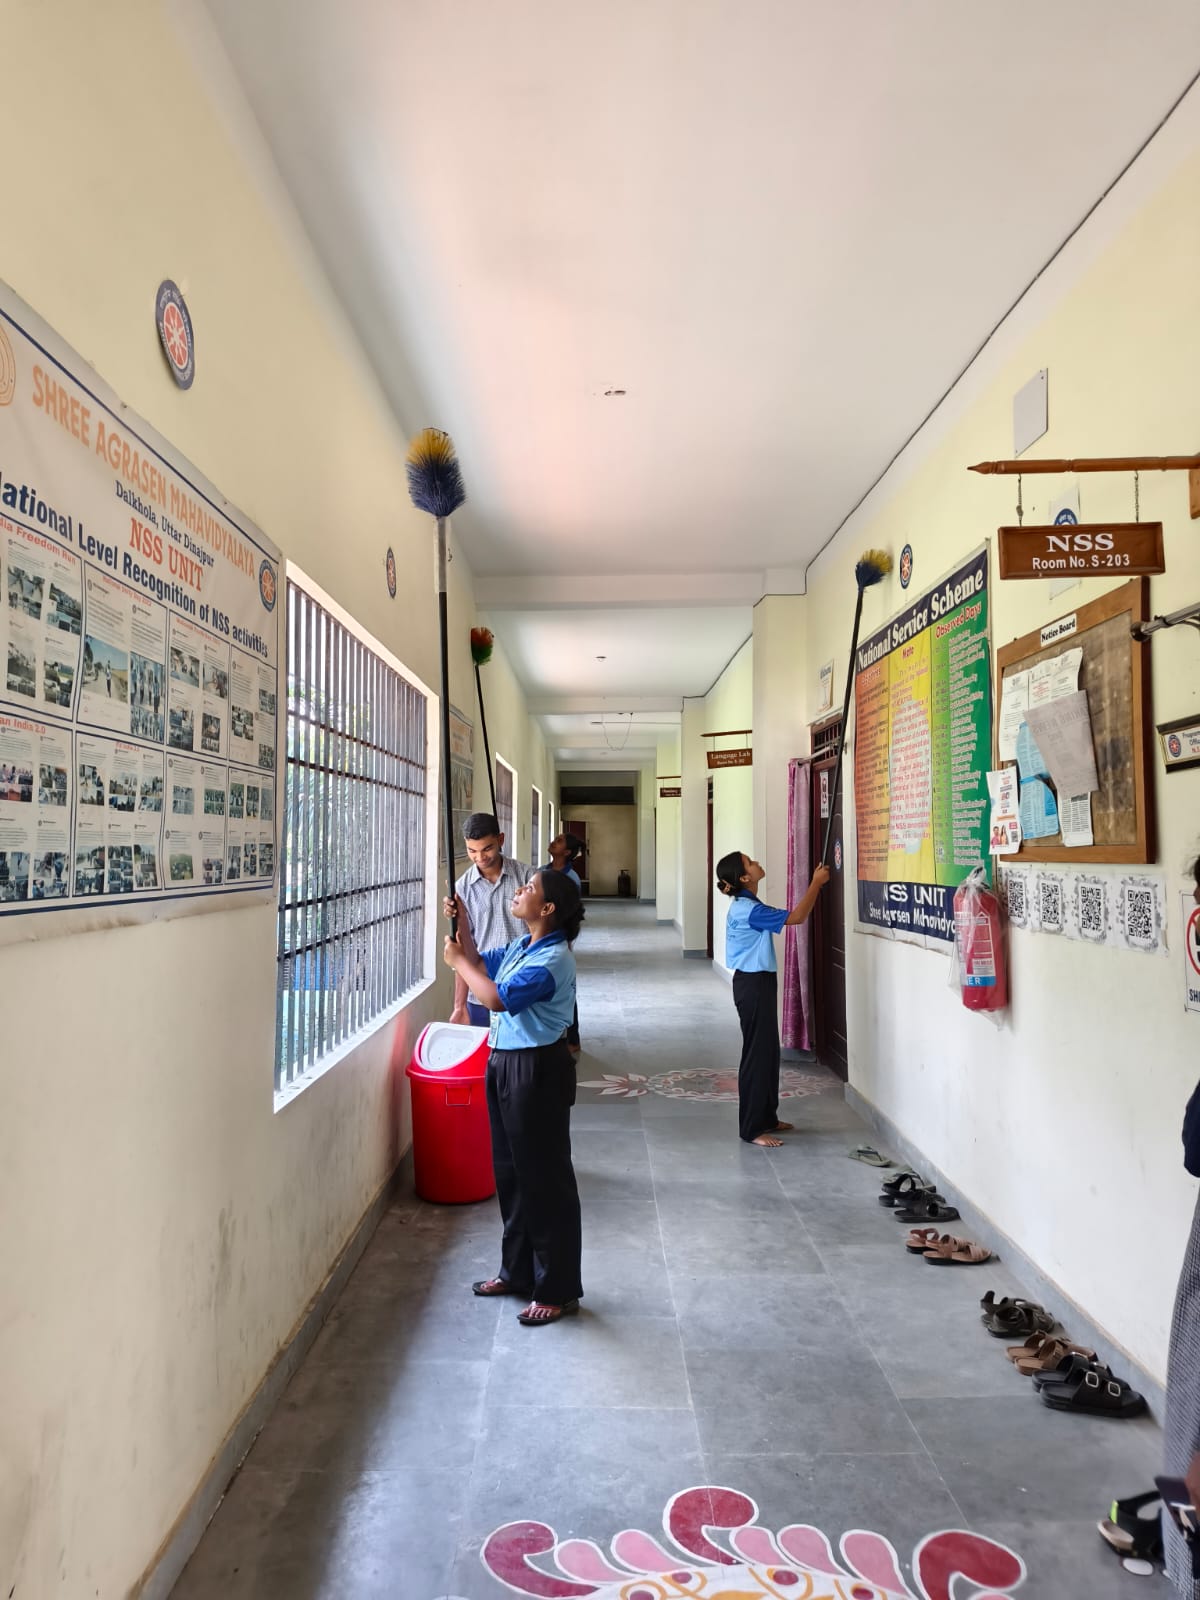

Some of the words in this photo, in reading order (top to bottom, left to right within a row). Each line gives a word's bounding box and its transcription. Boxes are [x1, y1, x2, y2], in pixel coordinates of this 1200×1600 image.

[32, 364, 90, 449] SHREE
[96, 421, 167, 510] AGRASEN
[169, 482, 256, 580] MAHAVIDYALAYA
[116, 480, 159, 529] Dalkhola,
[161, 516, 183, 545] Uttar
[183, 533, 214, 568] Dinajpur
[16, 526, 60, 557] Freedom
[129, 517, 163, 565] NSS
[168, 544, 203, 592] UNIT
[1045, 532, 1114, 553] NSS
[0, 471, 73, 542] ational
[78, 522, 118, 570] Level
[123, 551, 196, 617] Recognition
[199, 604, 210, 623] of
[212, 607, 230, 636] NSS
[232, 625, 268, 659] activities
[1032, 556, 1067, 570] Room
[1069, 555, 1089, 568] No.
[858, 627, 891, 672] National
[891, 608, 929, 648] Service
[930, 568, 984, 620] Scheme
[935, 608, 965, 640] Observed
[1041, 628, 1059, 643] Notice
[1058, 617, 1076, 634] Board
[913, 884, 946, 908] UNIT
